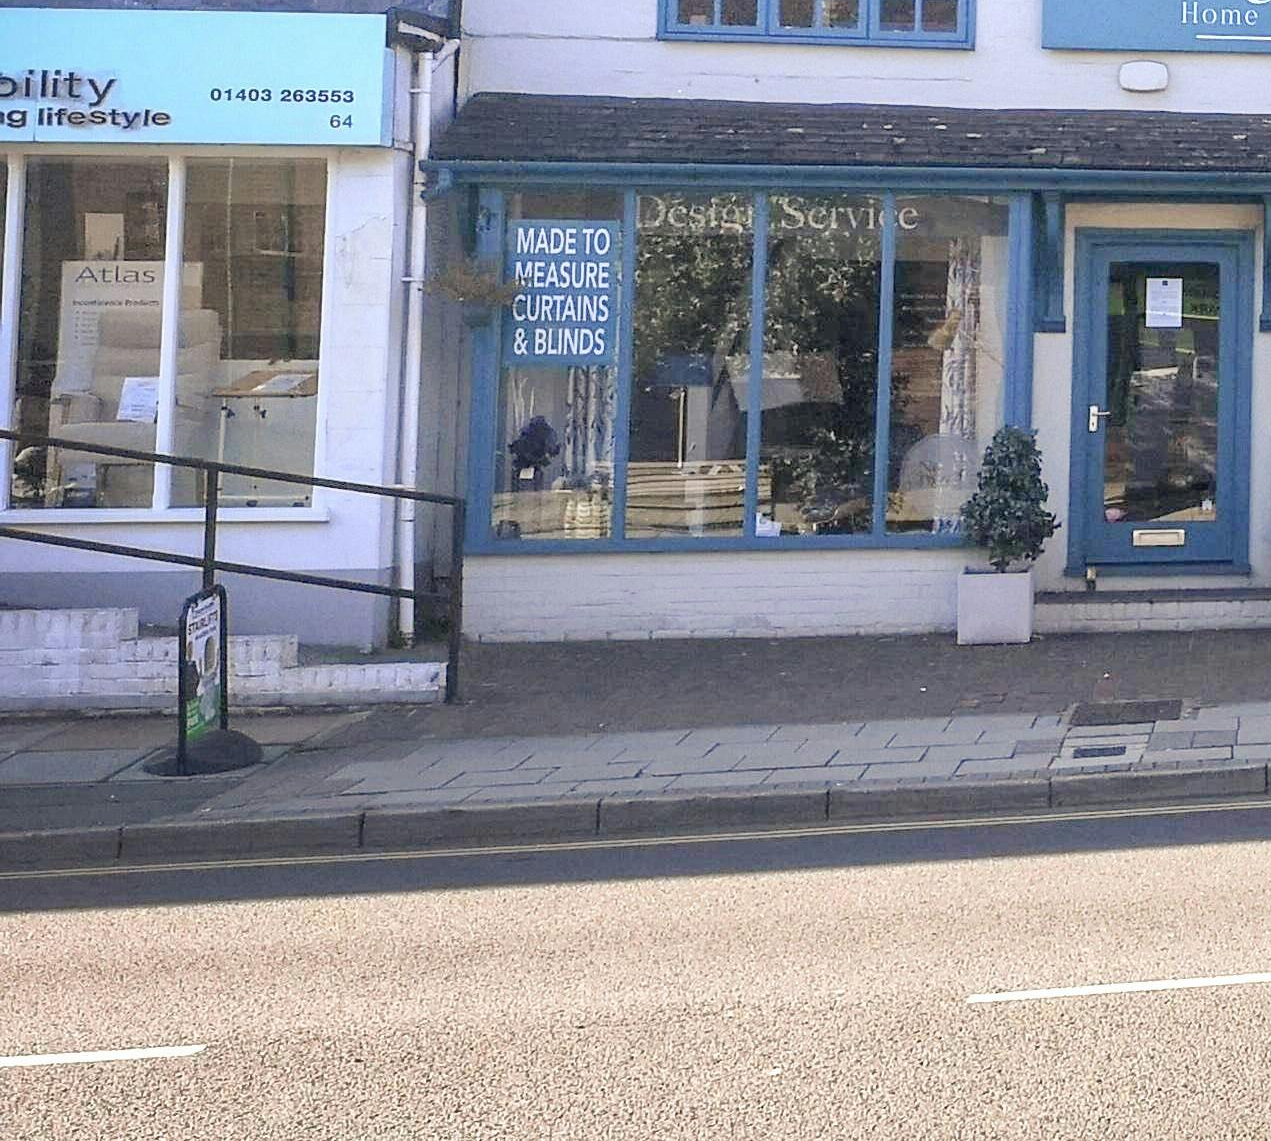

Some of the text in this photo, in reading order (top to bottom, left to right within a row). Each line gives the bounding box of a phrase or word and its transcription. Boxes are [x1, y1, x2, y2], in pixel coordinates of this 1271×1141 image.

[1181, 1, 1259, 27] Home
[210, 88, 355, 103] 01403 263553
[0, 106, 171, 131] g lifestyle
[330, 114, 353, 128] 64
[516, 227, 611, 255] MADE TO
[74, 265, 156, 284] Atlas
[514, 261, 610, 288] MEASURE
[512, 294, 609, 322] CURTAINS
[513, 327, 605, 356] & BLINDS
